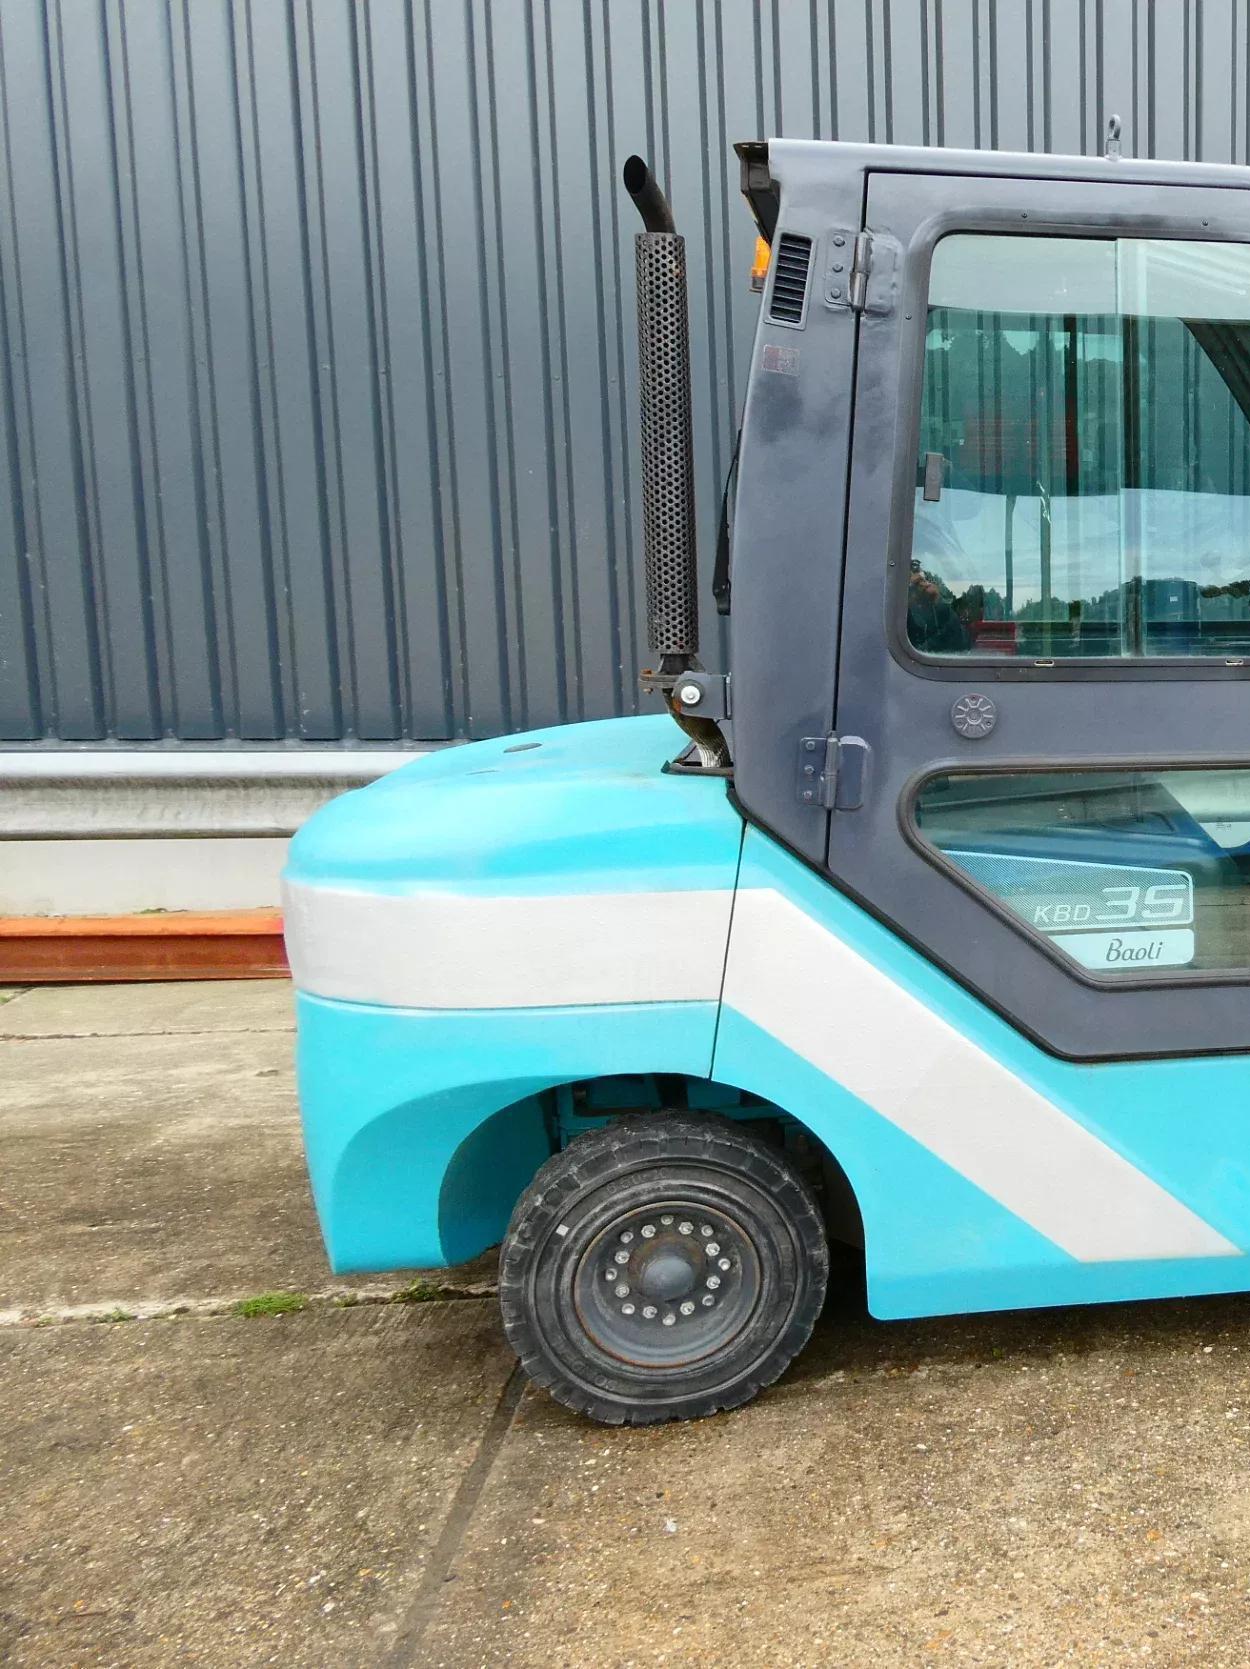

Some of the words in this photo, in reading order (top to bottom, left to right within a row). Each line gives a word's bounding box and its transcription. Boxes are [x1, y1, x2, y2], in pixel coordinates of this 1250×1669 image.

[1034, 904, 1091, 923] KBD
[1096, 884, 1187, 920] 35
[1105, 938, 1163, 962] Baoli
